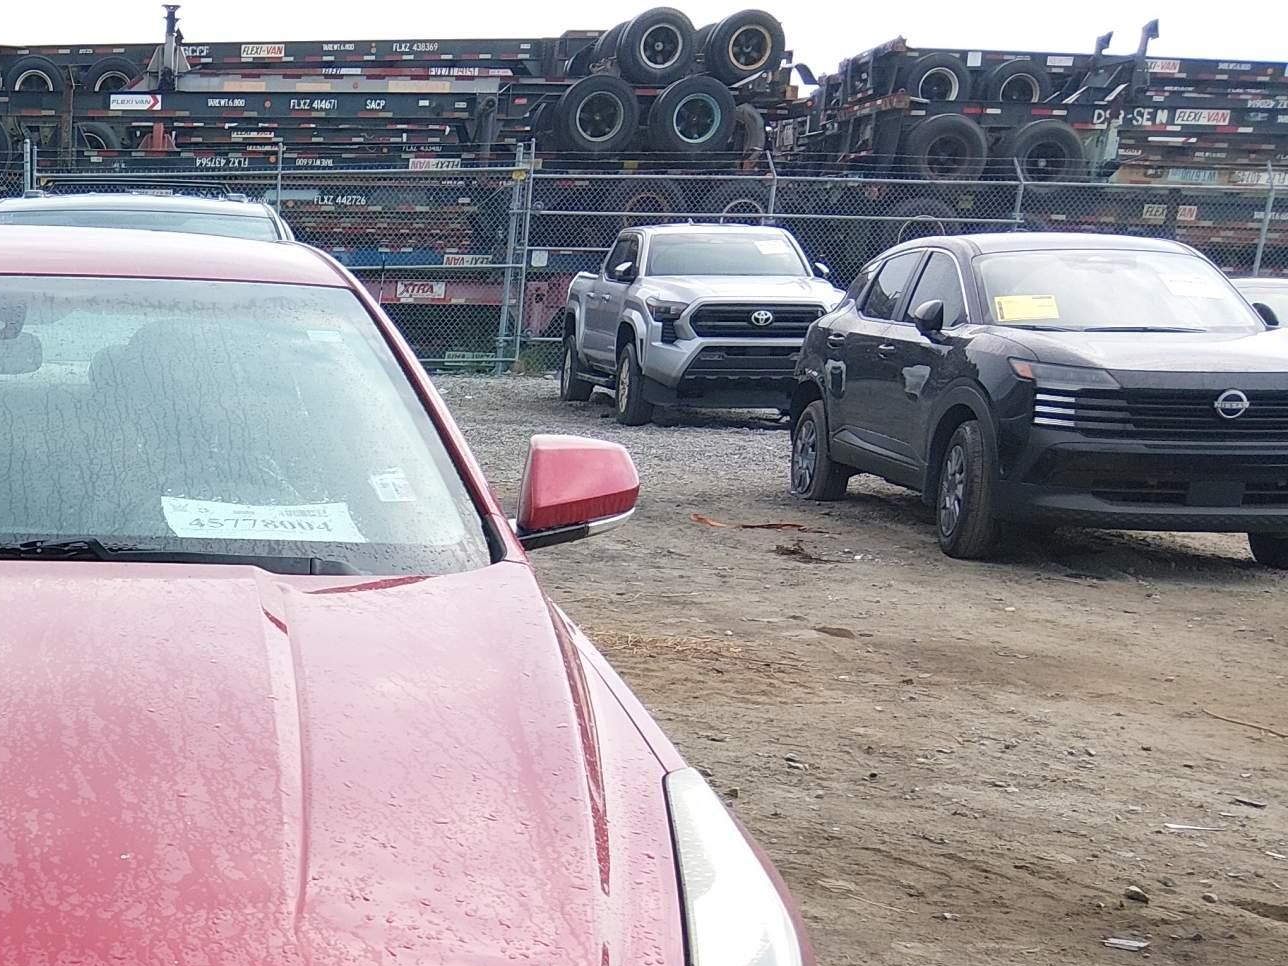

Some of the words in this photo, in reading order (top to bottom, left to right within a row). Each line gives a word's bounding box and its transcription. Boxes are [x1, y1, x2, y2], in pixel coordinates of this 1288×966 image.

[242, 45, 283, 55] FLEXI-VAN
[290, 100, 310, 109] FLXZ
[365, 100, 386, 109] SACP
[1177, 110, 1228, 123] FLEXI-VAN
[228, 157, 249, 168] FLXZ
[314, 195, 333, 205] FLXZ
[335, 195, 367, 205] 442726
[188, 517, 333, 533] 45778004
